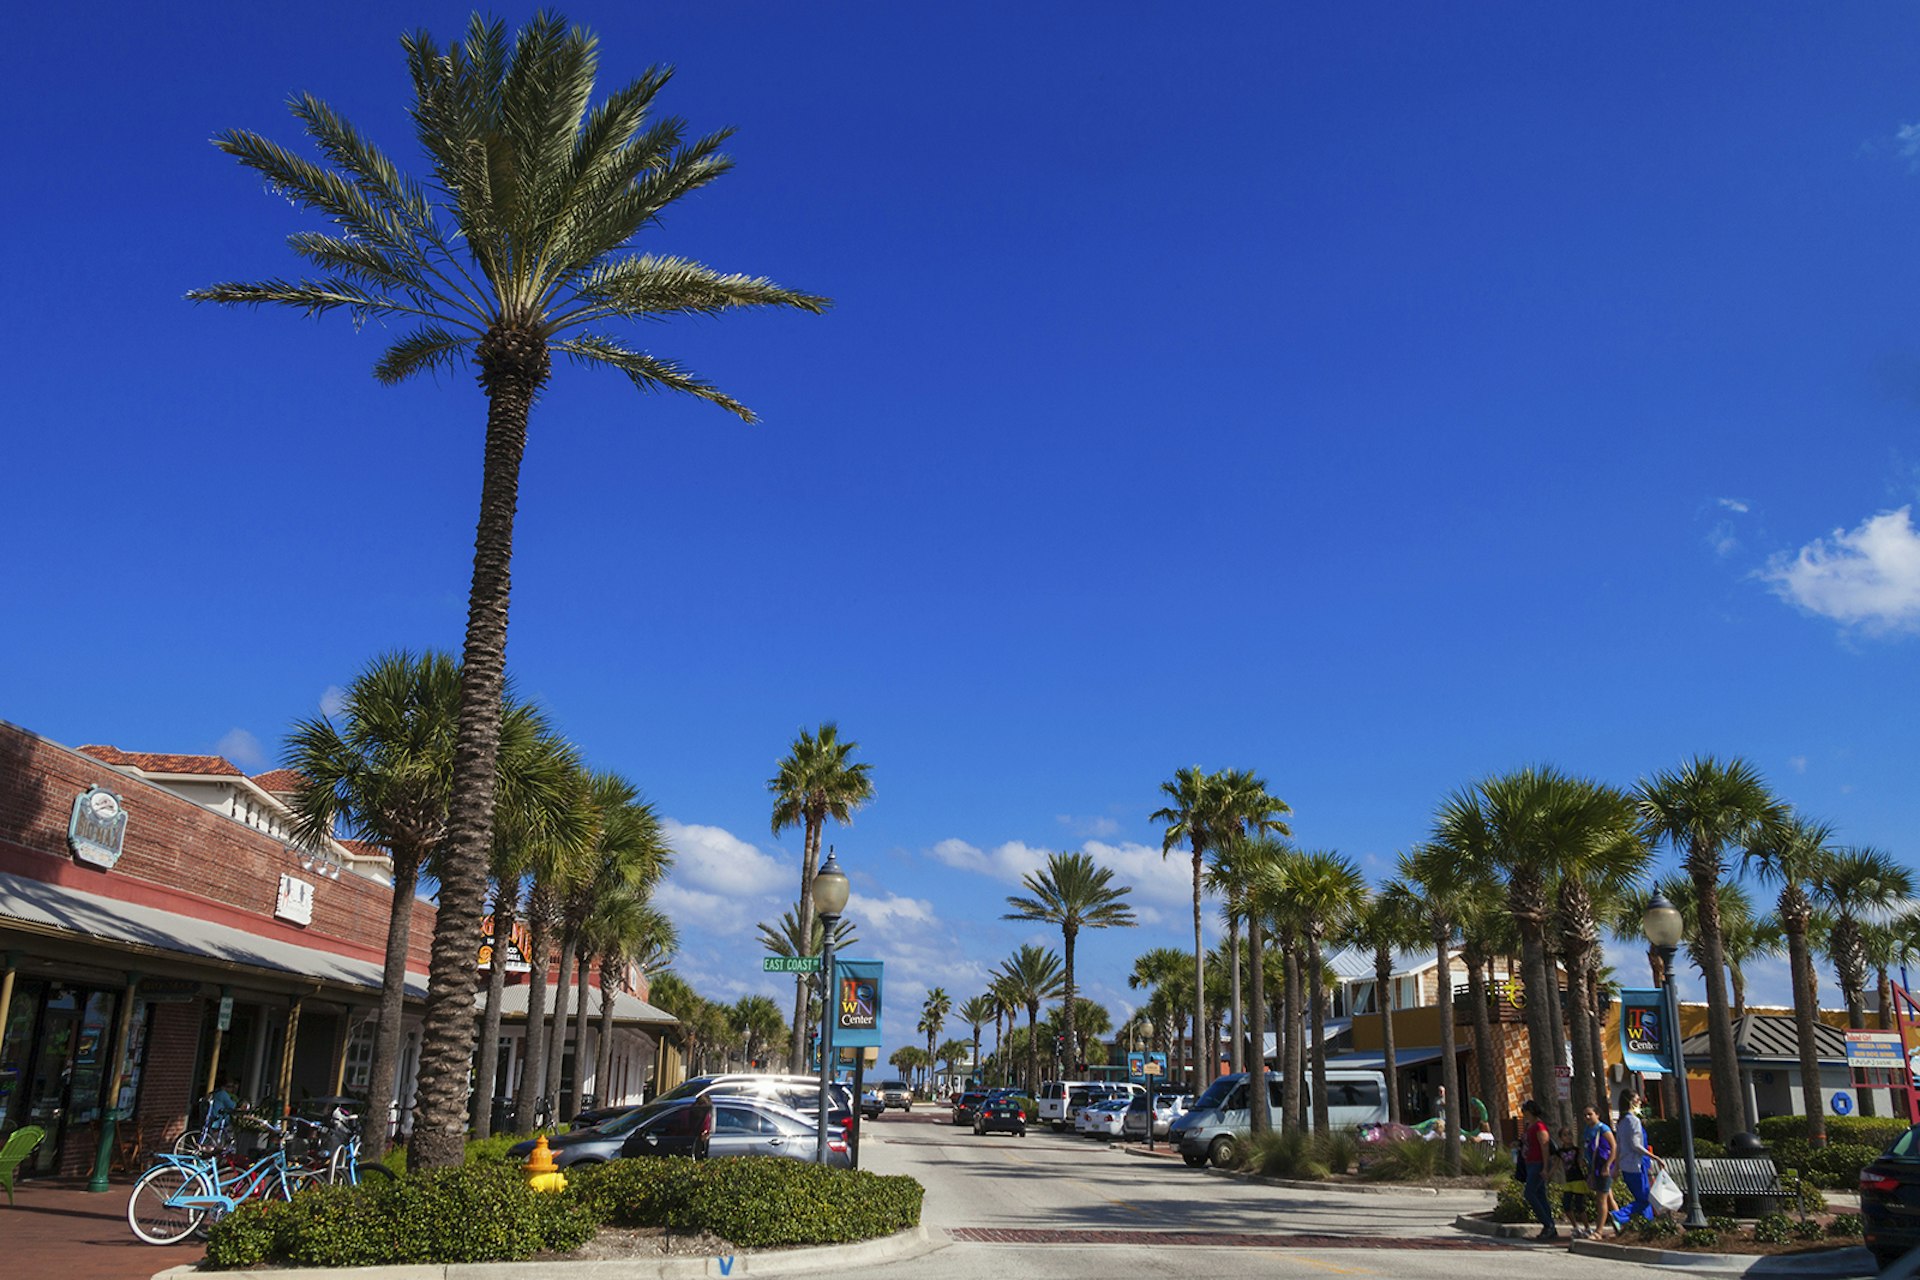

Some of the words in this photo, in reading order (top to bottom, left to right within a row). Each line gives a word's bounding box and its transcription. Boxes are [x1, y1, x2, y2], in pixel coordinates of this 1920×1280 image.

[764, 959, 784, 970] EAST
[787, 959, 812, 970] COAST
[841, 1014, 873, 1026] Center
[1629, 1040, 1659, 1051] Center
